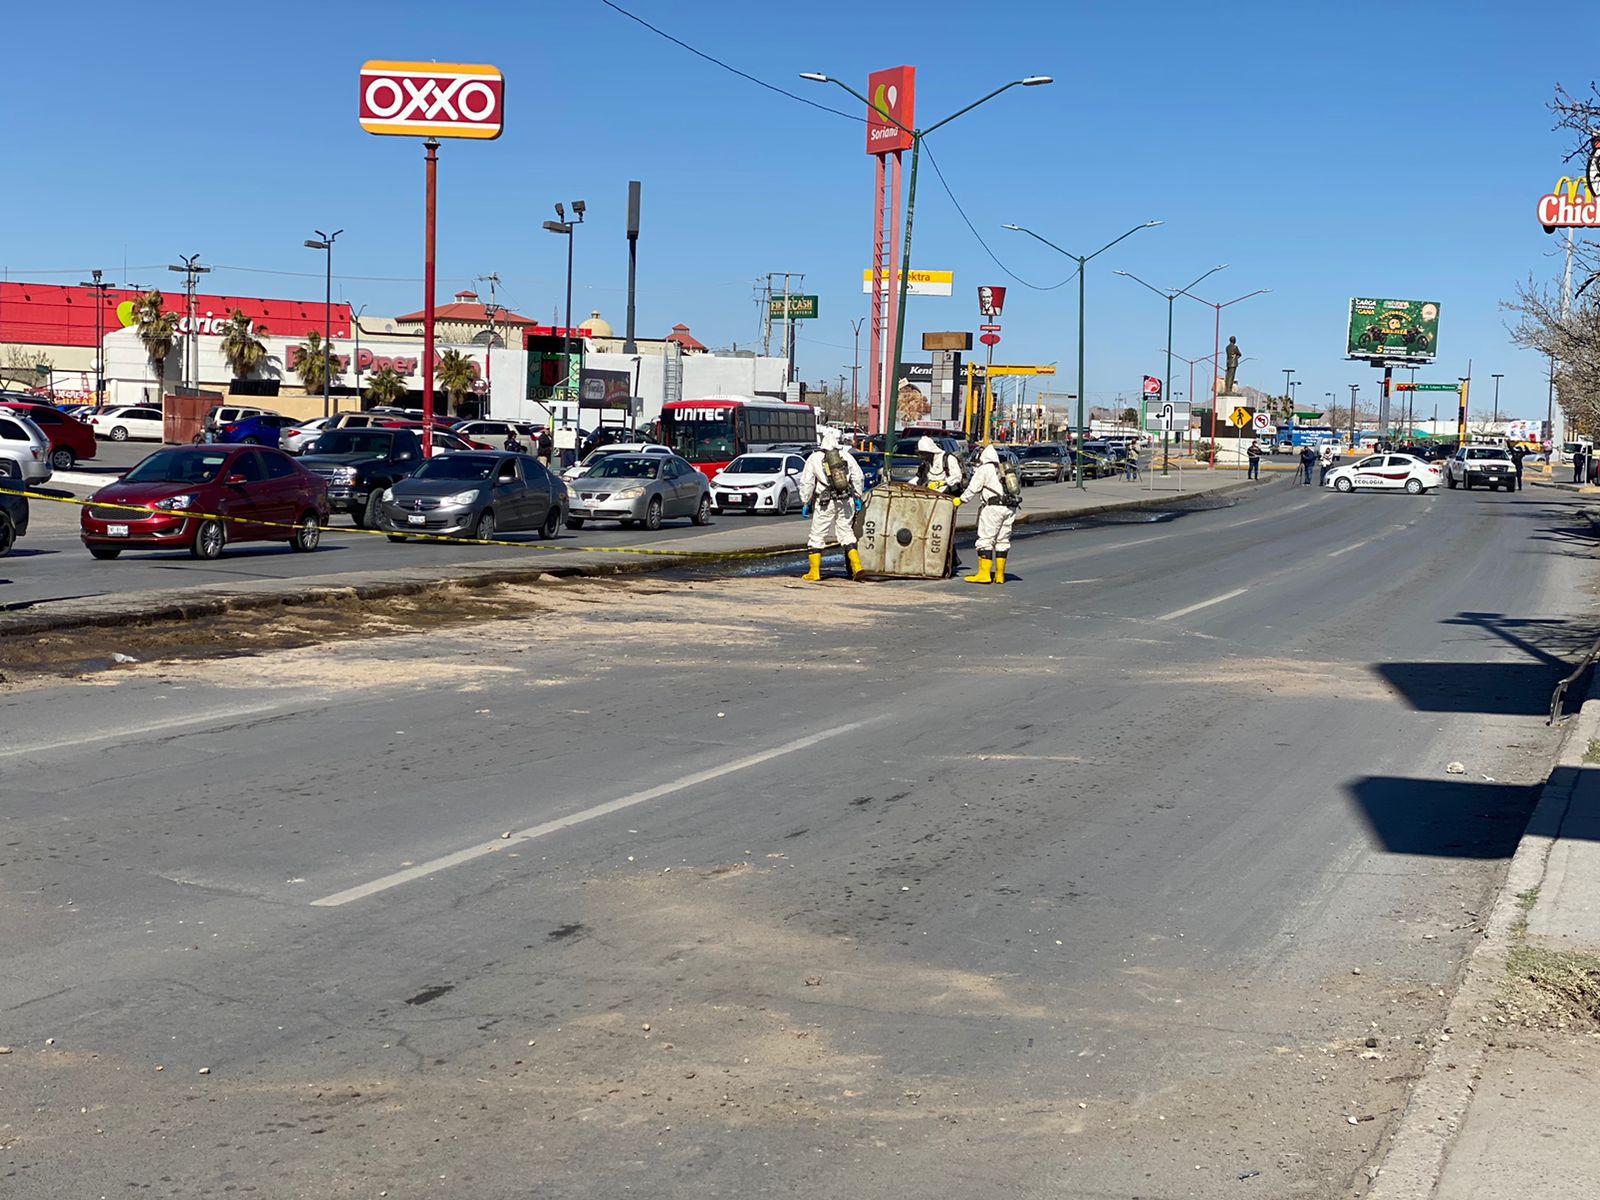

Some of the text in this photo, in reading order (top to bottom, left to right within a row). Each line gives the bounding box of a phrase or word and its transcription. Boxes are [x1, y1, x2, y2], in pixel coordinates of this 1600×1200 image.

[365, 77, 496, 121] OXXO
[871, 127, 898, 140] Soriana
[1376, 345, 1383, 353] 5
[674, 408, 724, 421] UNITEC
[865, 520, 875, 550] GRFS
[931, 524, 942, 553] GRFS
